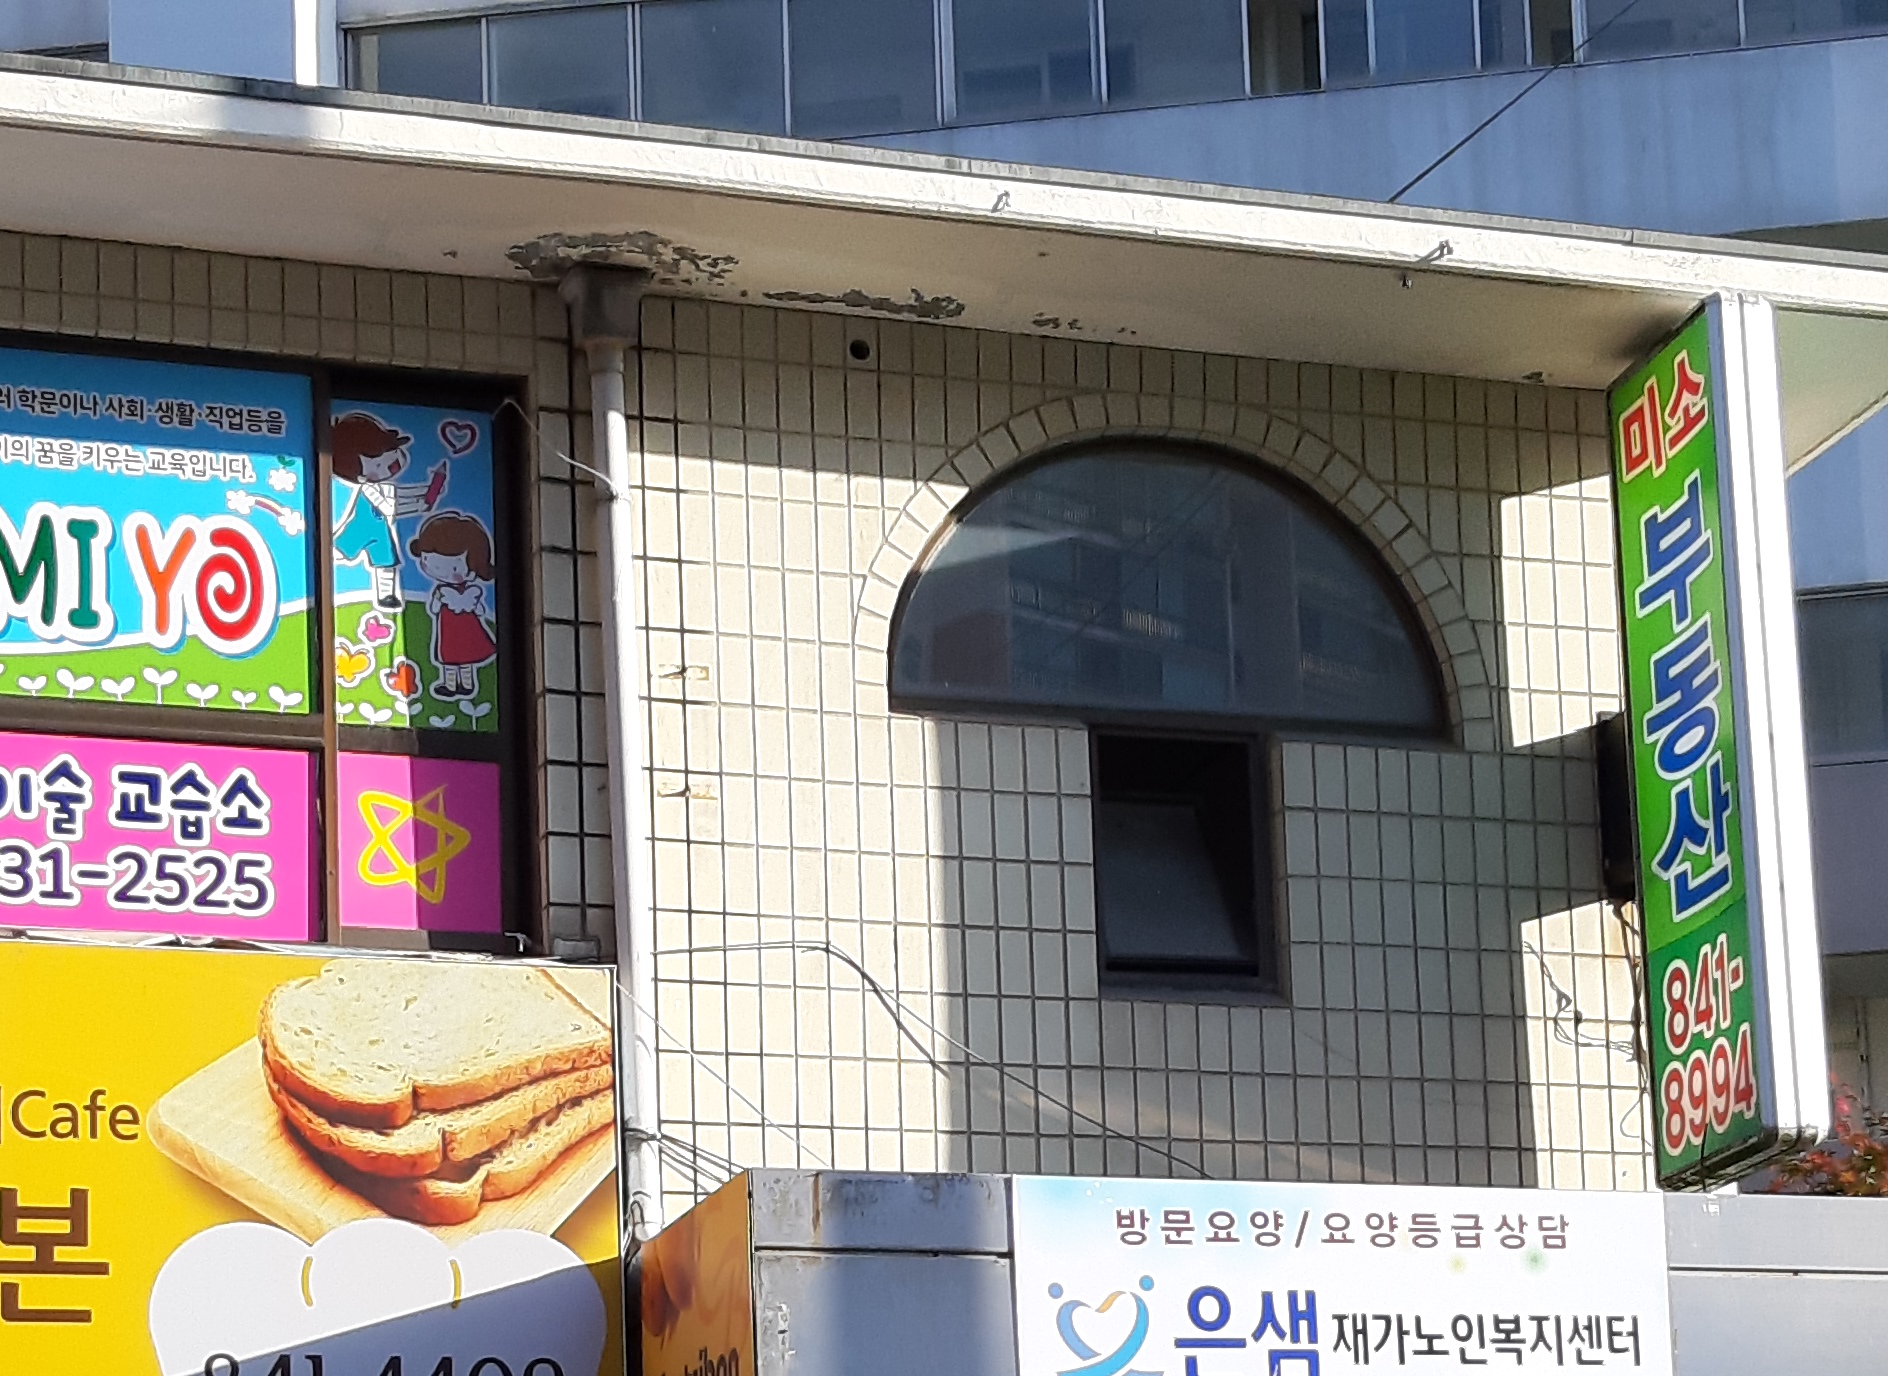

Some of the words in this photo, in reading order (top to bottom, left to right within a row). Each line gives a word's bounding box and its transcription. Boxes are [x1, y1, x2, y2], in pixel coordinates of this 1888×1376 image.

[18, 388, 99, 417] 학문이나
[1623, 355, 1707, 476] 미소
[35, 441, 77, 466] 꿈을
[82, 442, 143, 470] 키우는
[148, 451, 254, 480] 교육입니다.
[134, 524, 263, 641] YO
[1637, 476, 1730, 914] 부동산
[115, 769, 263, 840] 교습소
[1667, 939, 1740, 1053] 841-
[1664, 1029, 1753, 1152] 8994
[1332, 1311, 1642, 1367] 재가노인복지센터
